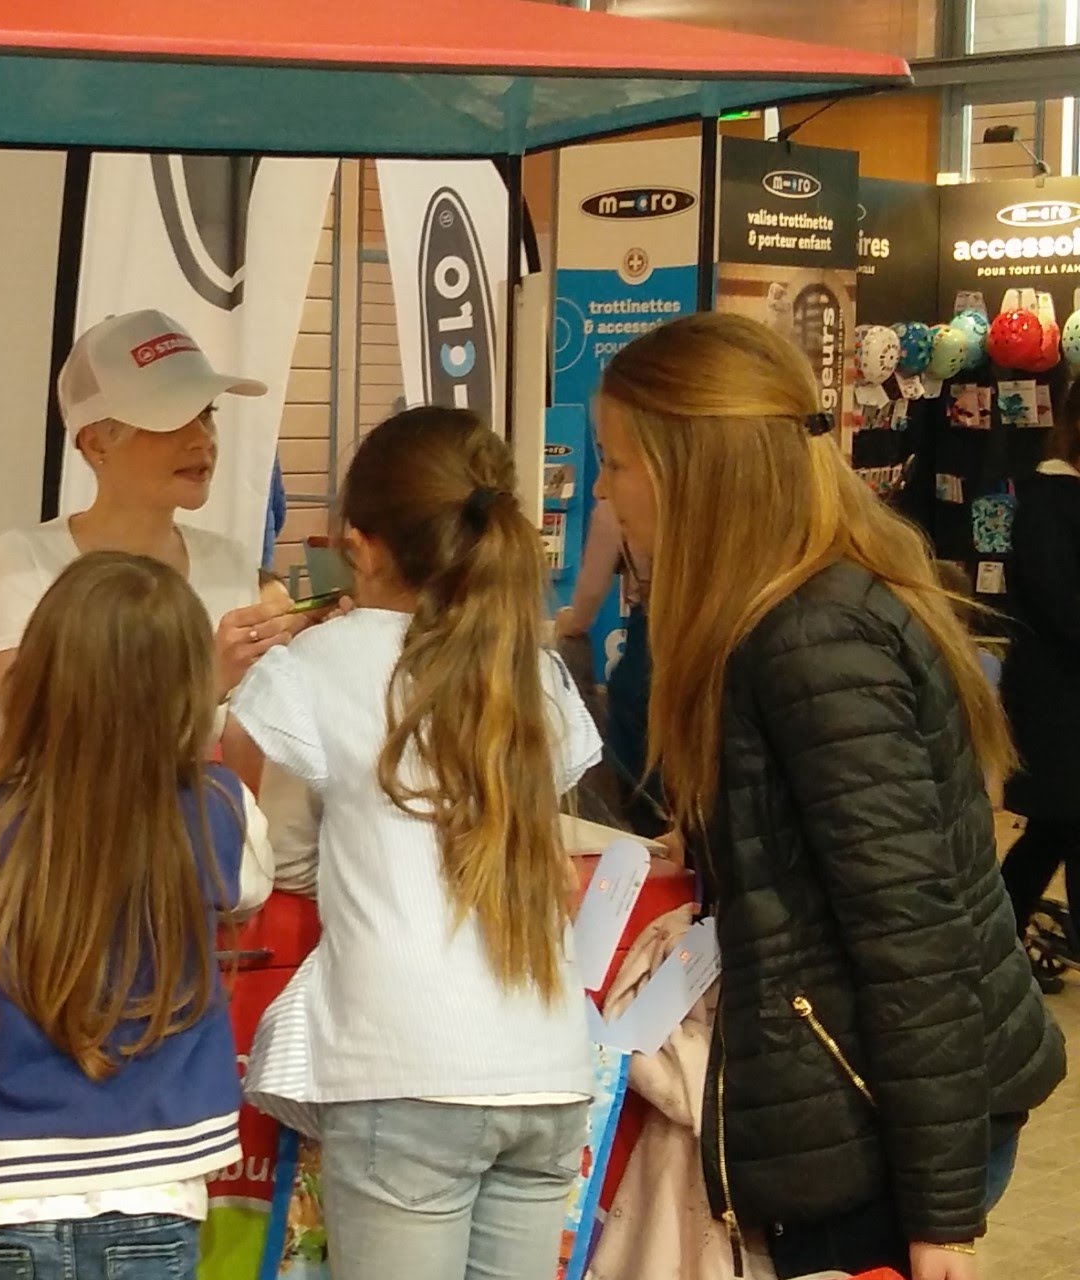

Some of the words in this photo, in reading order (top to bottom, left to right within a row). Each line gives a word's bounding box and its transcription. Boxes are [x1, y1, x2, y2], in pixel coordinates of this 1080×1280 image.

[747, 209, 777, 227] valise
[779, 212, 834, 231] trottinette
[758, 233, 797, 251] porteur
[798, 233, 832, 251] enfant
[857, 229, 890, 258] ires
[977, 266, 1006, 277] POUR
[1008, 265, 1042, 275] TOUTE
[1044, 264, 1058, 274] LA
[588, 298, 681, 314] trottinettes
